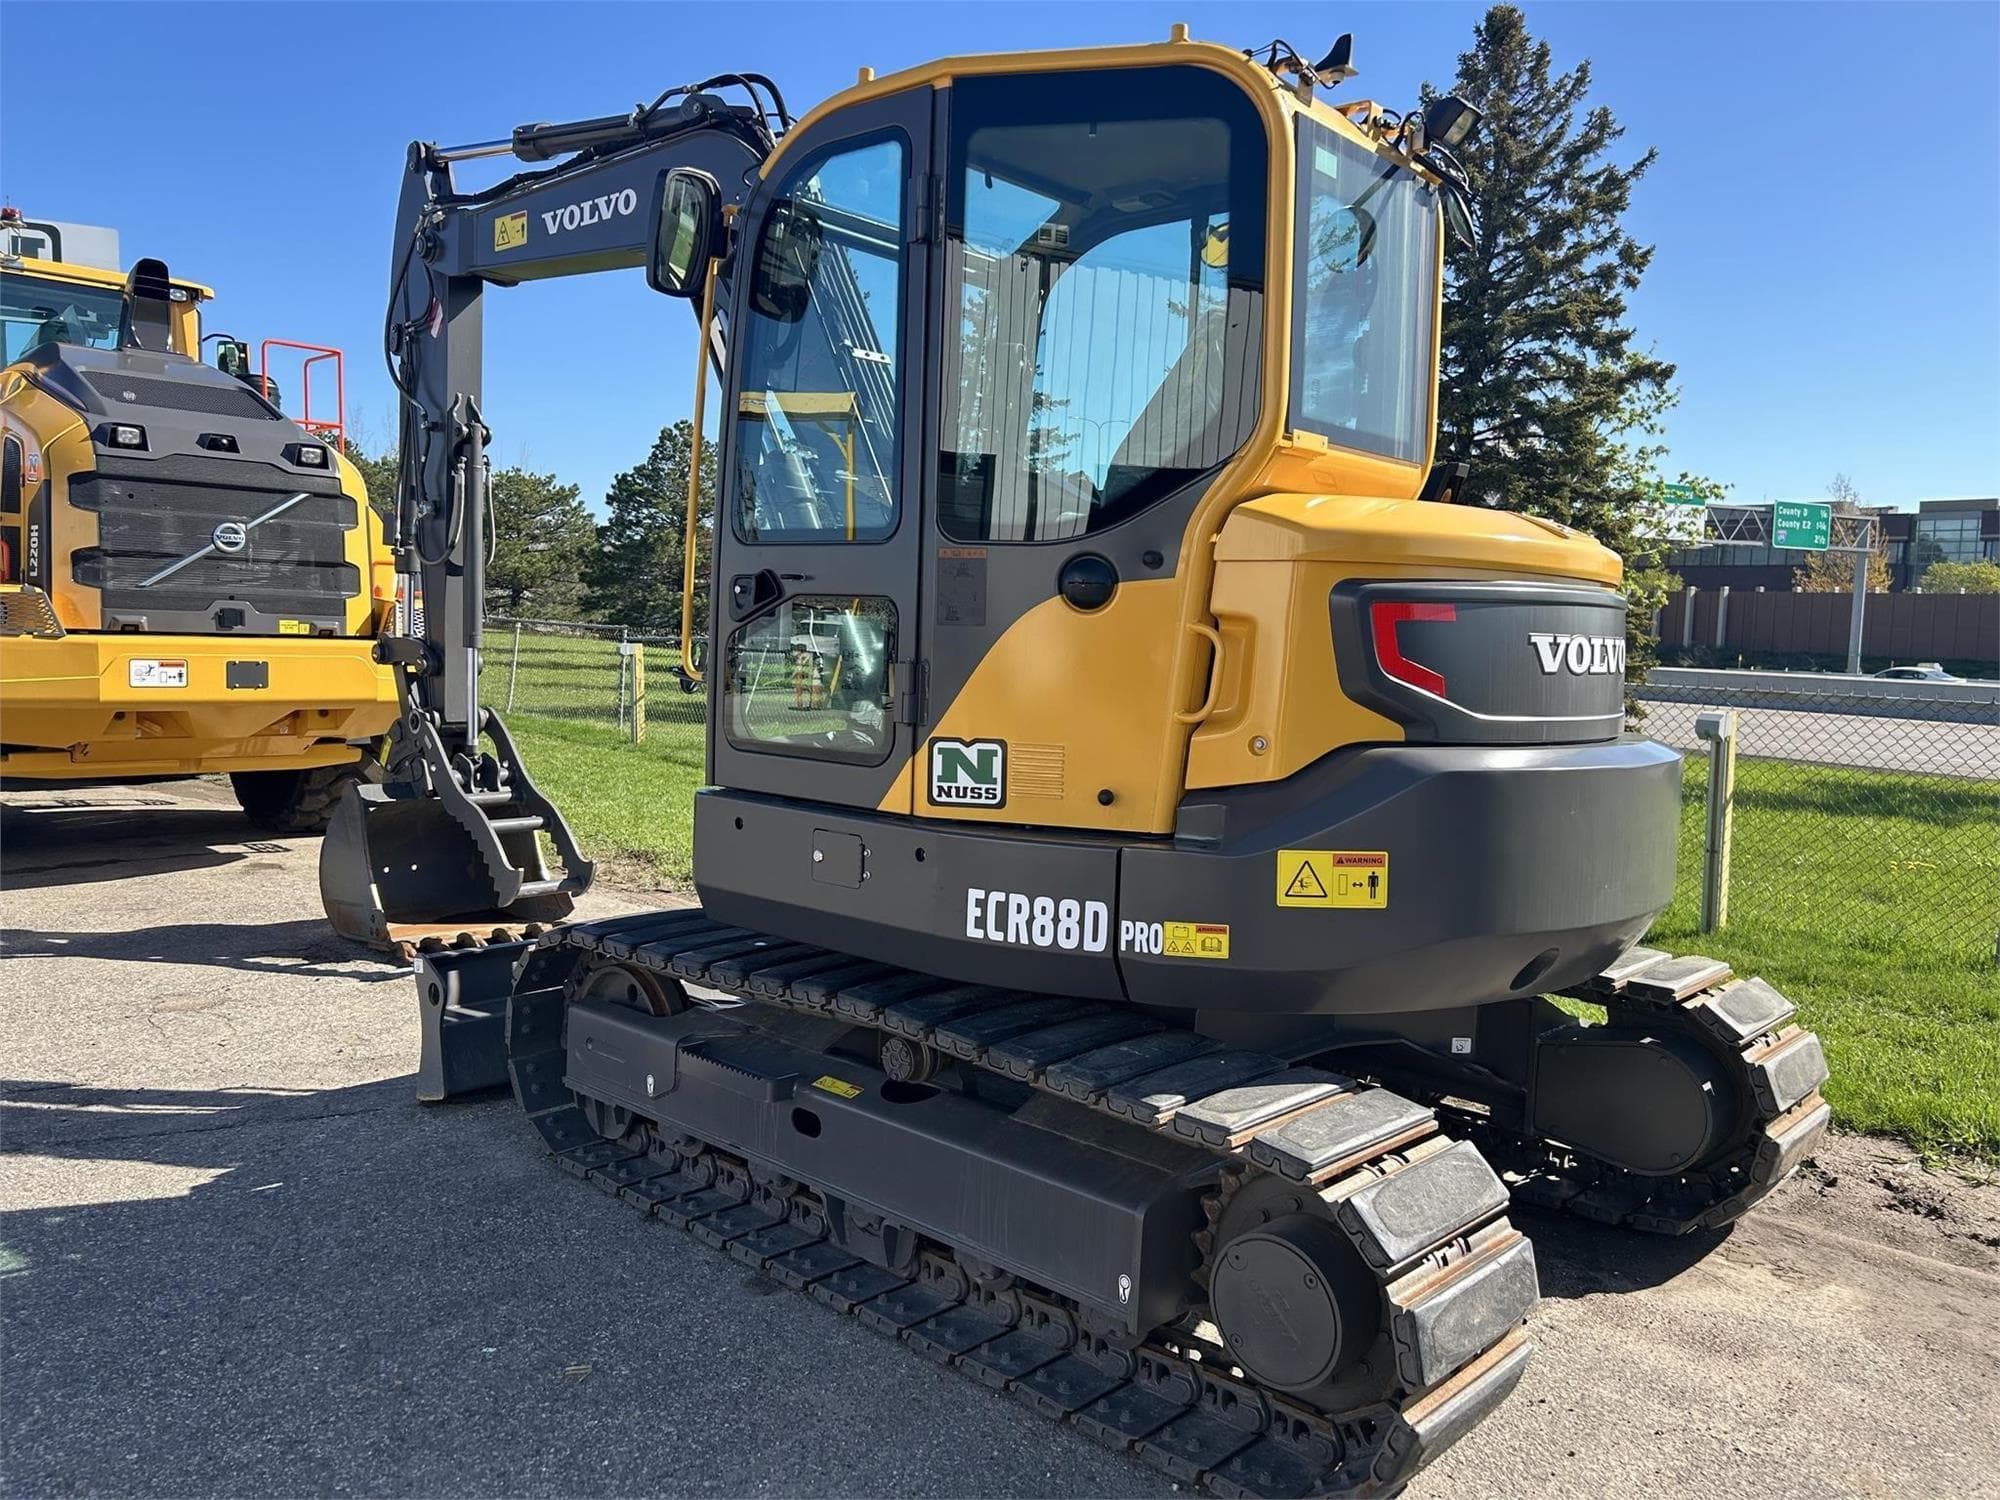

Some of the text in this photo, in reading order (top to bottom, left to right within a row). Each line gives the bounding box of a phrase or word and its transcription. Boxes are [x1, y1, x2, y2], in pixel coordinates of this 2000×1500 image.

[542, 188, 638, 235] VOLVO
[1777, 518, 1801, 530] County
[1778, 506, 1801, 518] County
[30, 524, 39, 577] L220H
[1528, 633, 1626, 675] VOLVO
[937, 747, 998, 785] N
[936, 785, 998, 800] NUSS
[966, 888, 1163, 955] ECR88D PRO
